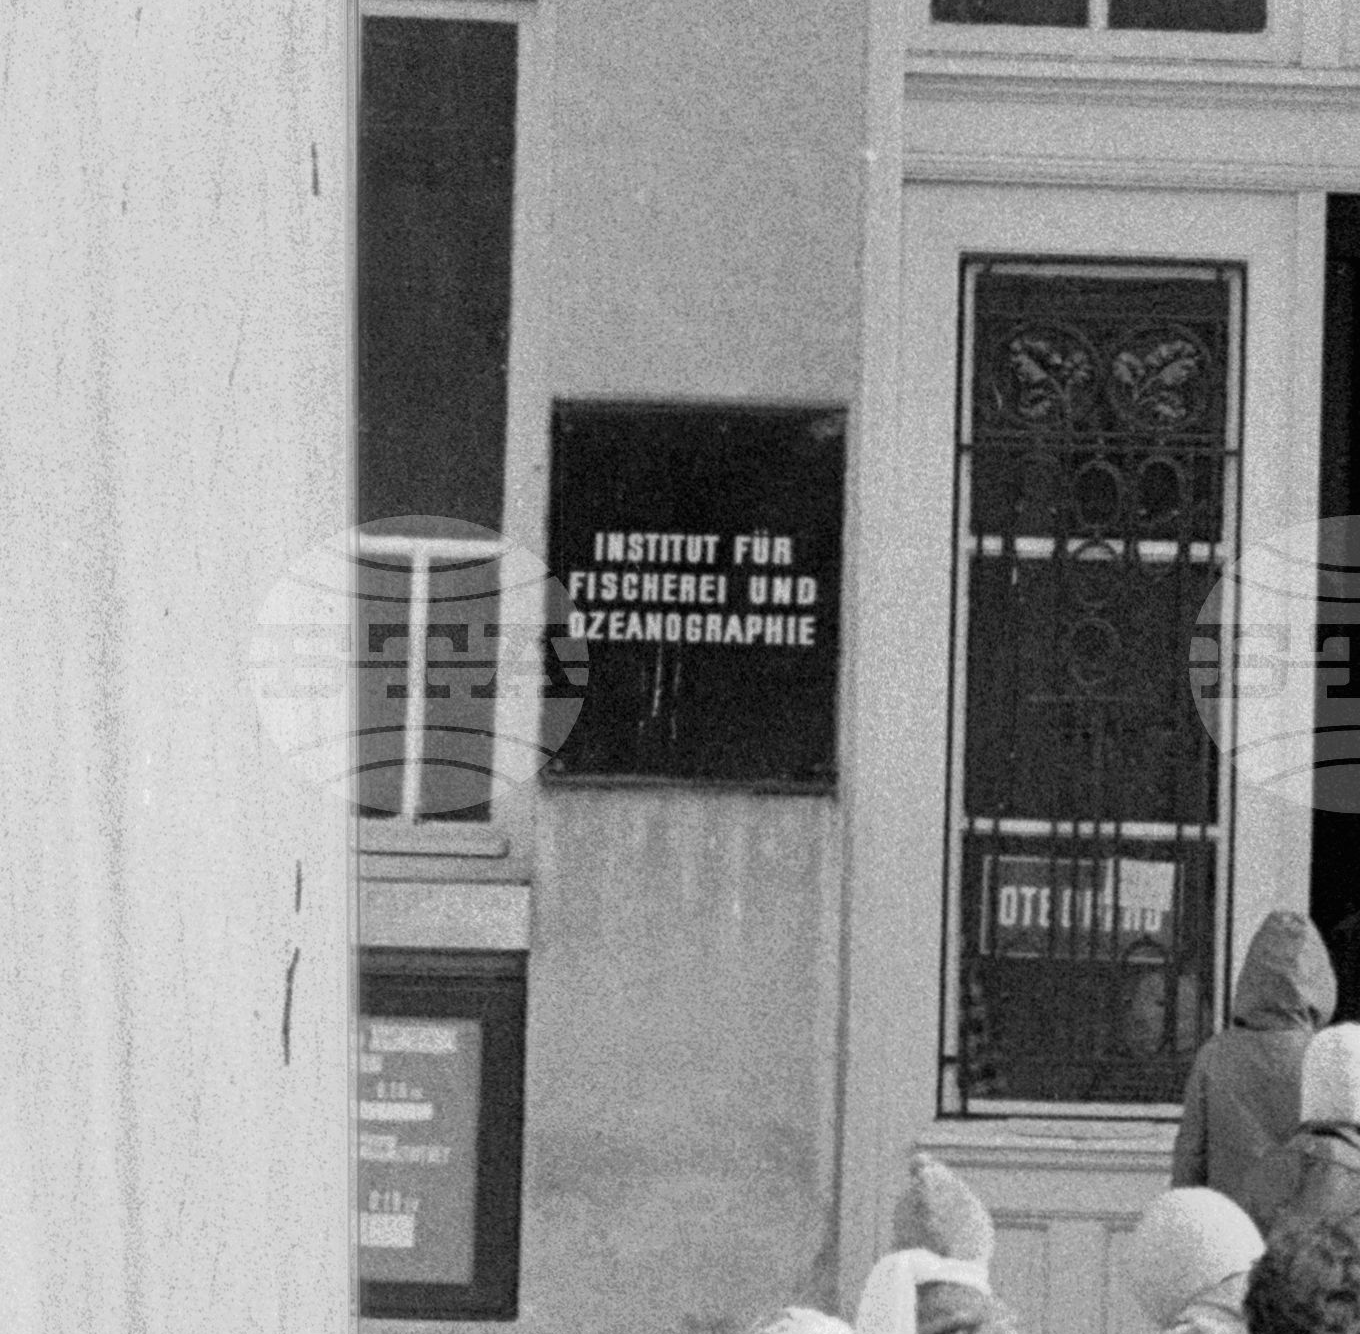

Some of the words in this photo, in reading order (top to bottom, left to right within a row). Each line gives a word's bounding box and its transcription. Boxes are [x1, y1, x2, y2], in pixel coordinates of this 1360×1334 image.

[594, 531, 720, 564] INSTITUT
[734, 528, 793, 565] FÜR
[568, 571, 727, 604] FISCHEREI
[749, 575, 818, 605] UND
[568, 610, 816, 646] OZEANOGRAPHIE
